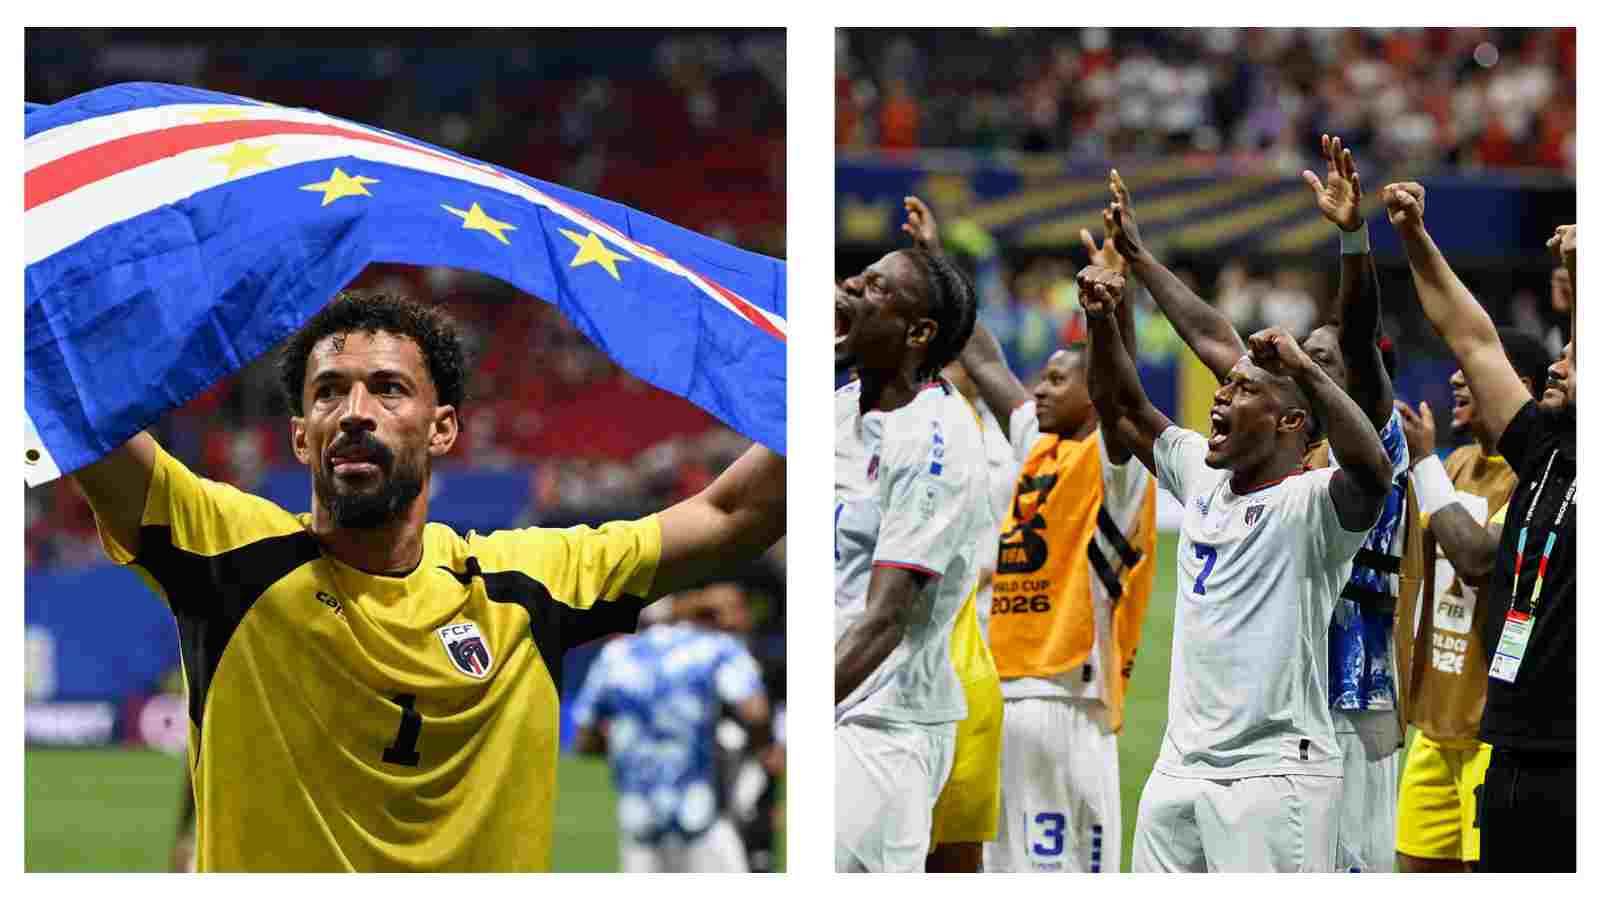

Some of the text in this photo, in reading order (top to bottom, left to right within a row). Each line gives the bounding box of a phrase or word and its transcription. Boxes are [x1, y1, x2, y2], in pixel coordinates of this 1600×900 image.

[1193, 543, 1217, 595] 7
[1022, 580, 1050, 592] CUP
[992, 595, 1051, 614] 2026
[1438, 602, 1465, 618] FIFA
[441, 624, 473, 638] FCF
[383, 693, 420, 766] 1
